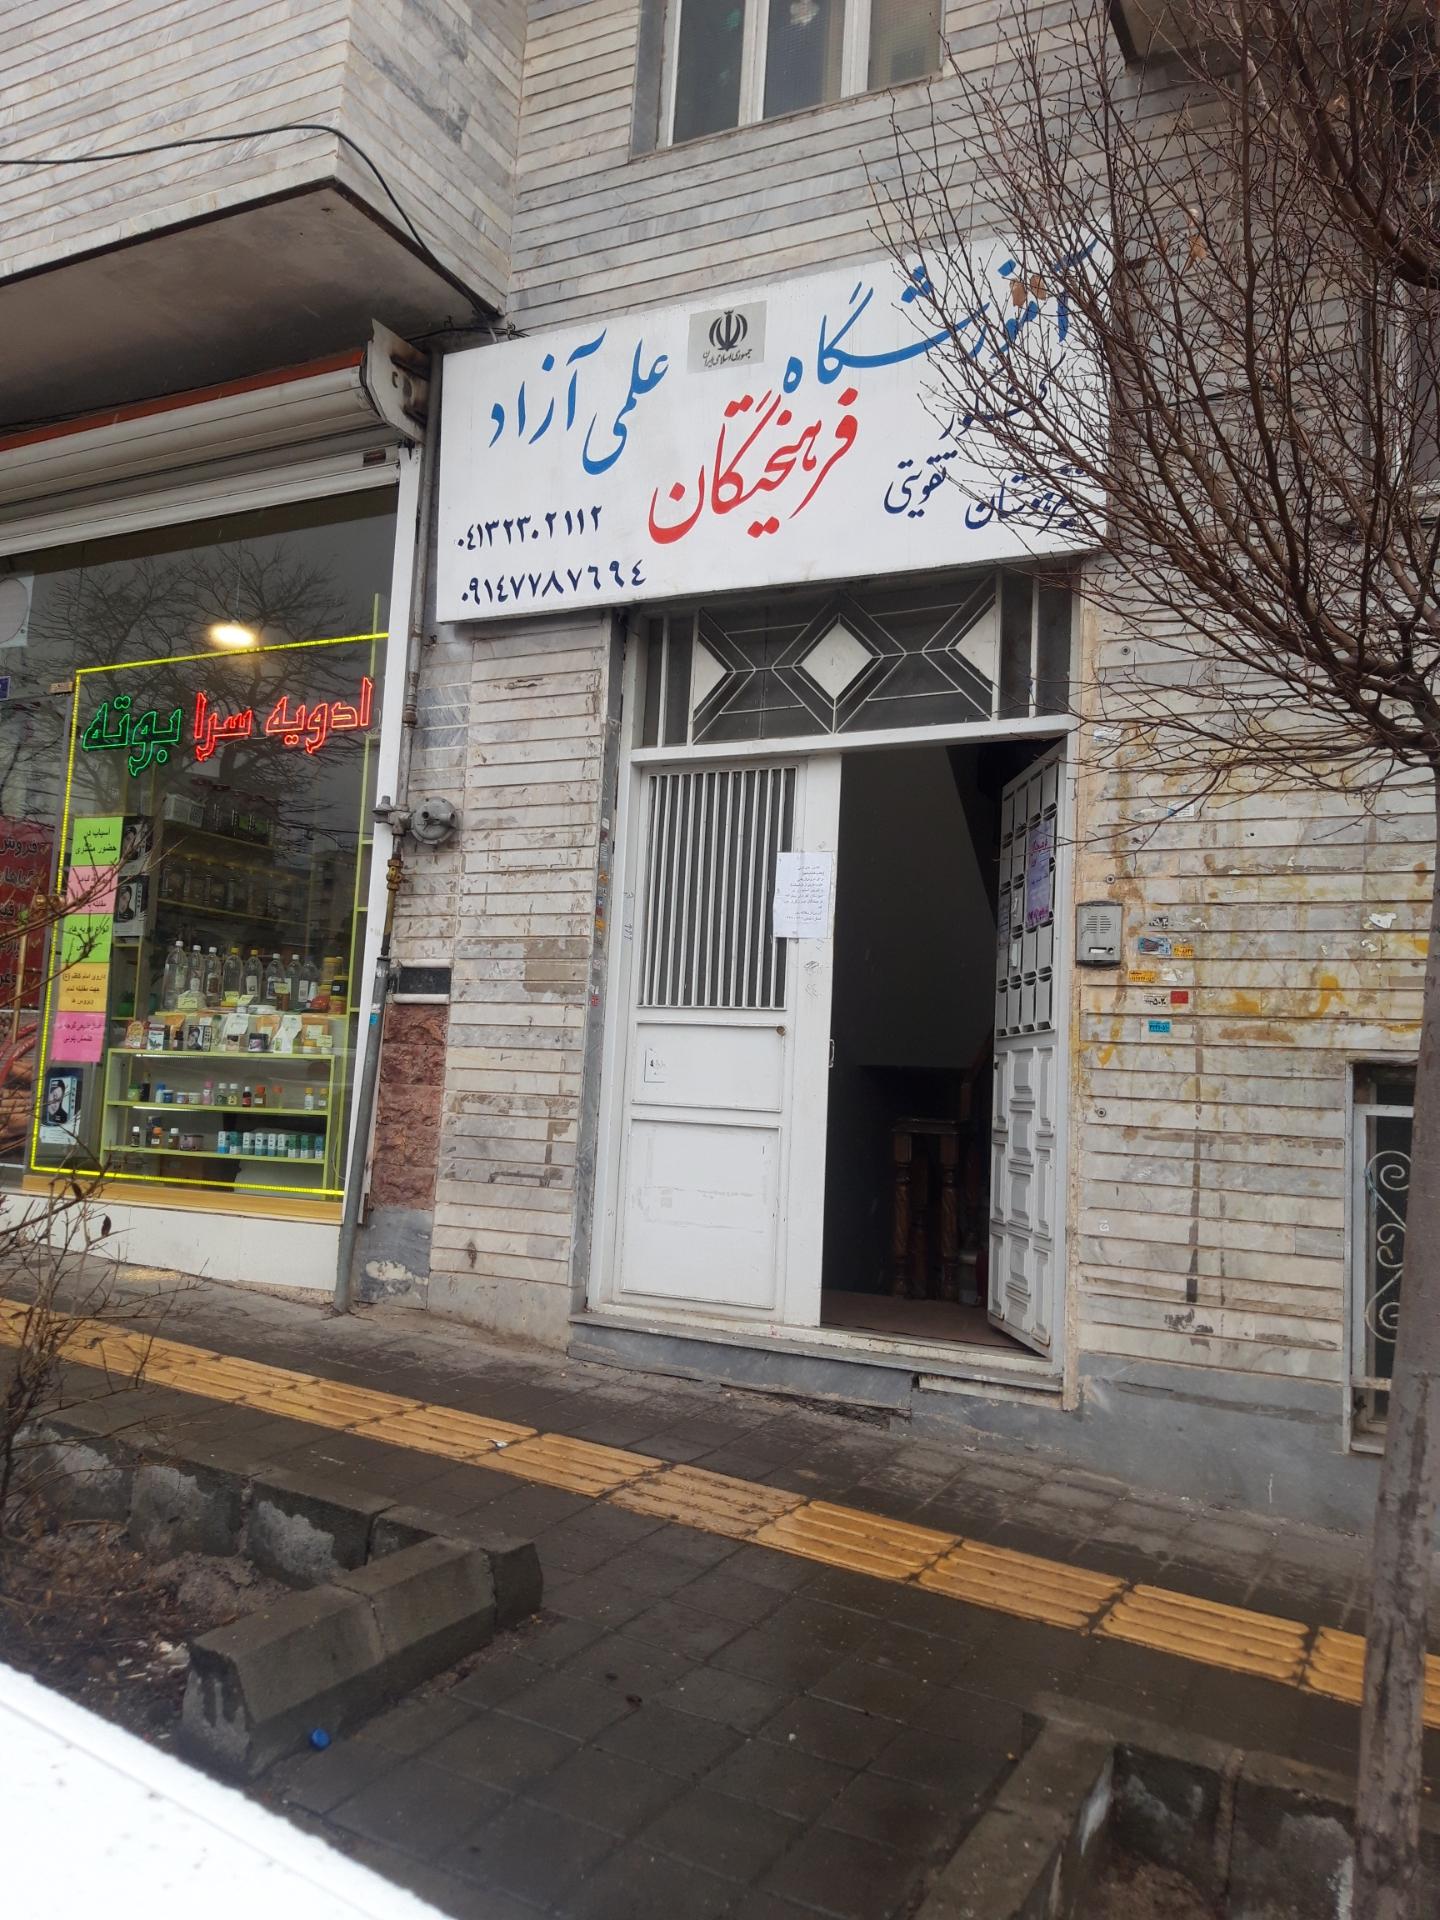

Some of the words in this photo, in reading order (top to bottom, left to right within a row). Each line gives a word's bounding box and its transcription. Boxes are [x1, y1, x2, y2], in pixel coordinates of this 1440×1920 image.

[783, 237, 1098, 394] آموزشگاه
[487, 329, 606, 448] آزاد
[582, 338, 670, 474] علمی
[648, 387, 859, 545] فرهیختگان
[883, 448, 958, 519] تقویتی
[81, 694, 184, 778] بوته
[193, 690, 253, 763] سرا
[265, 675, 374, 755] ادویه
